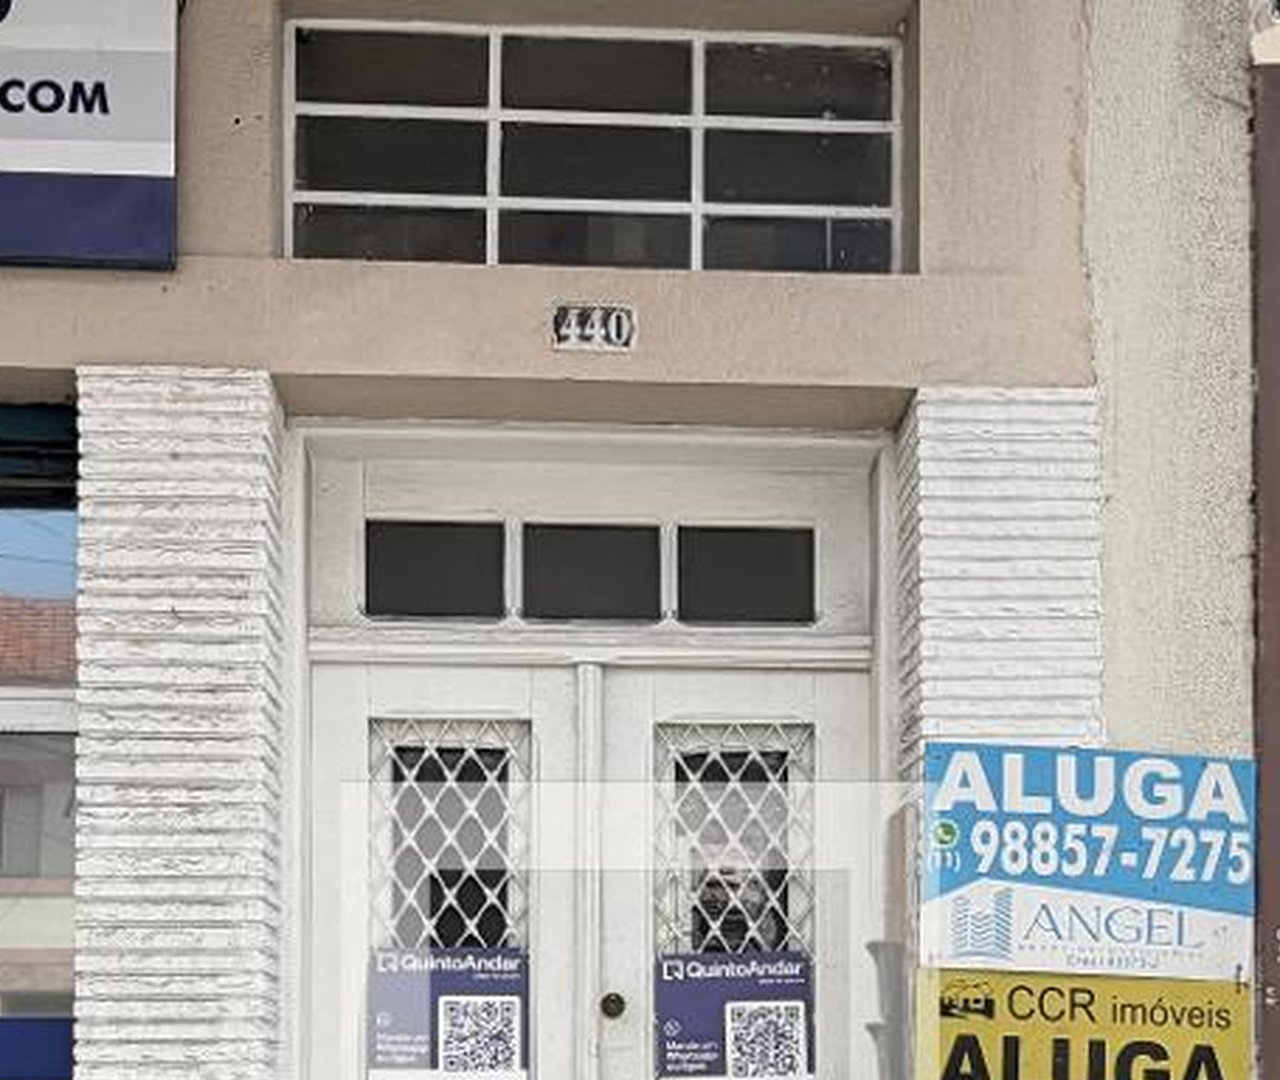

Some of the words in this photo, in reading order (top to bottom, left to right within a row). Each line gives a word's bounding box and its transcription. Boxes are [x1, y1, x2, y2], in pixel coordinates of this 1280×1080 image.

[559, 308, 631, 346] 440
[932, 750, 1249, 824] ALUGA
[970, 819, 1253, 885] 98857-7275
[1023, 902, 1204, 949] ANGEL
[401, 955, 521, 972] QuintoAndar
[686, 960, 803, 978] QuintoAndar
[1007, 984, 1097, 1023] CCR
[1111, 995, 1232, 1030] imóveis
